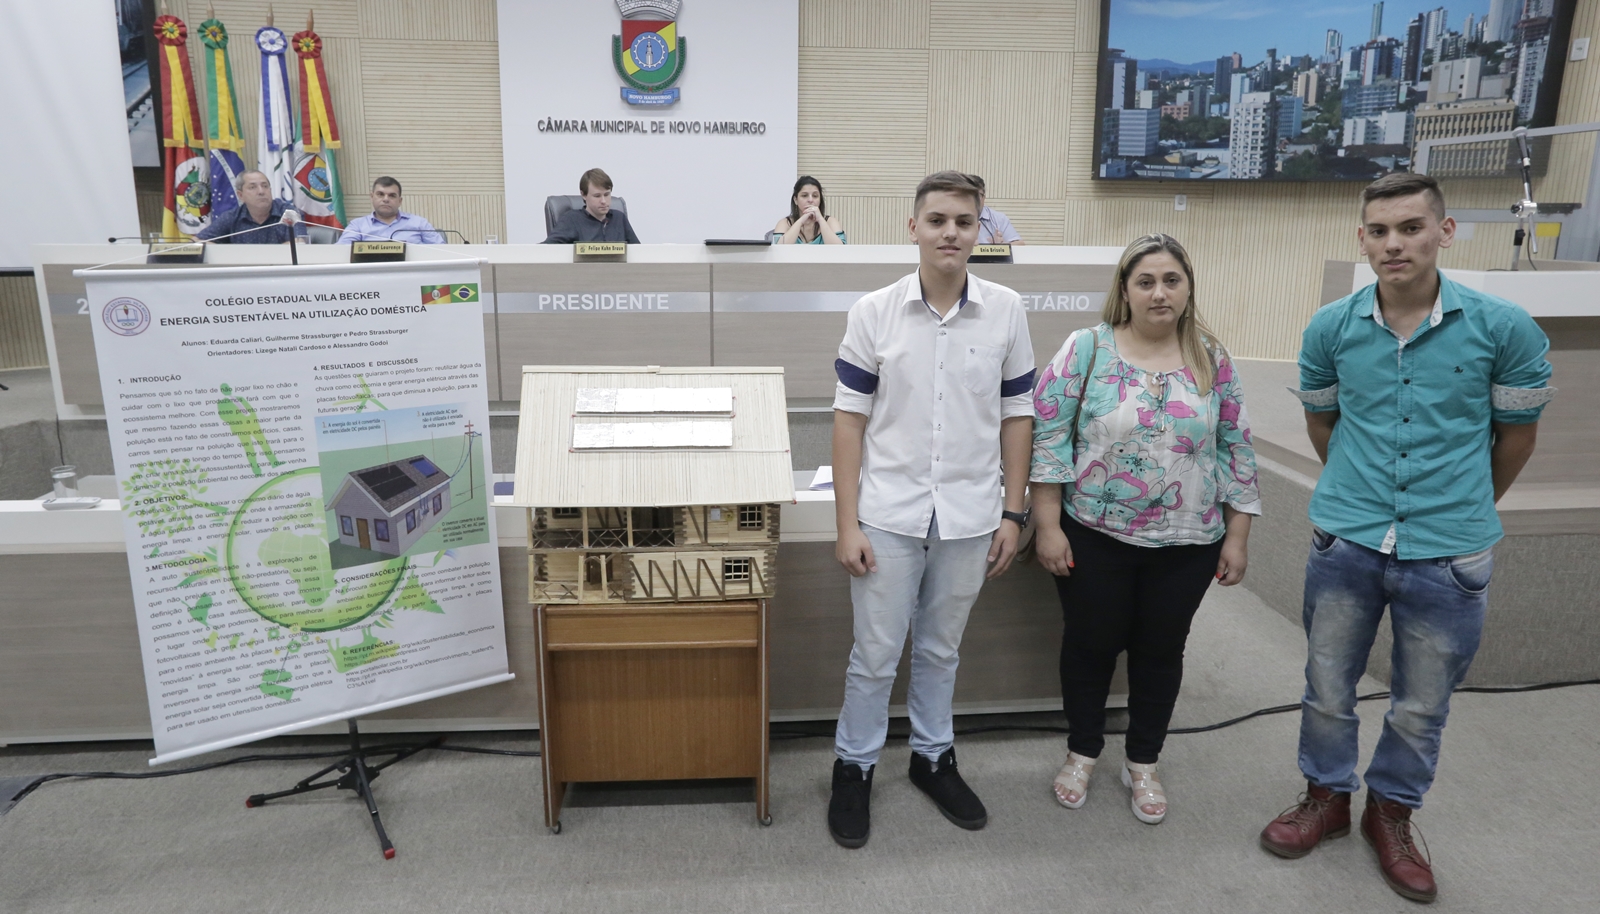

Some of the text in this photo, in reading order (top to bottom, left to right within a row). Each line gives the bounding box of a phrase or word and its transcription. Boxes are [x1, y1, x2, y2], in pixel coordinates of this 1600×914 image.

[538, 117, 766, 135] CÂMARA MUNICIPAL DE NOVO HAMBURGO
[205, 291, 381, 307] COLÉGIO ESTADUAL VILA BECKER
[539, 294, 669, 310] PRESIDENTE
[1021, 292, 1090, 310] ETÁRIO
[160, 304, 427, 326] ENERGIA SUSTENTÁVEL NA UTILIZAÇÃO DOMÉSTICA
[210, 337, 239, 345] Eduarda
[265, 334, 300, 342] Guilherme
[300, 332, 342, 340] Strassburger
[332, 341, 369, 349] Alessandro
[369, 339, 389, 347] Godoi
[320, 362, 366, 371] RESULTADOS
[376, 357, 419, 366] DISCUSSÕES
[129, 374, 182, 384] INTRODUÇÃO
